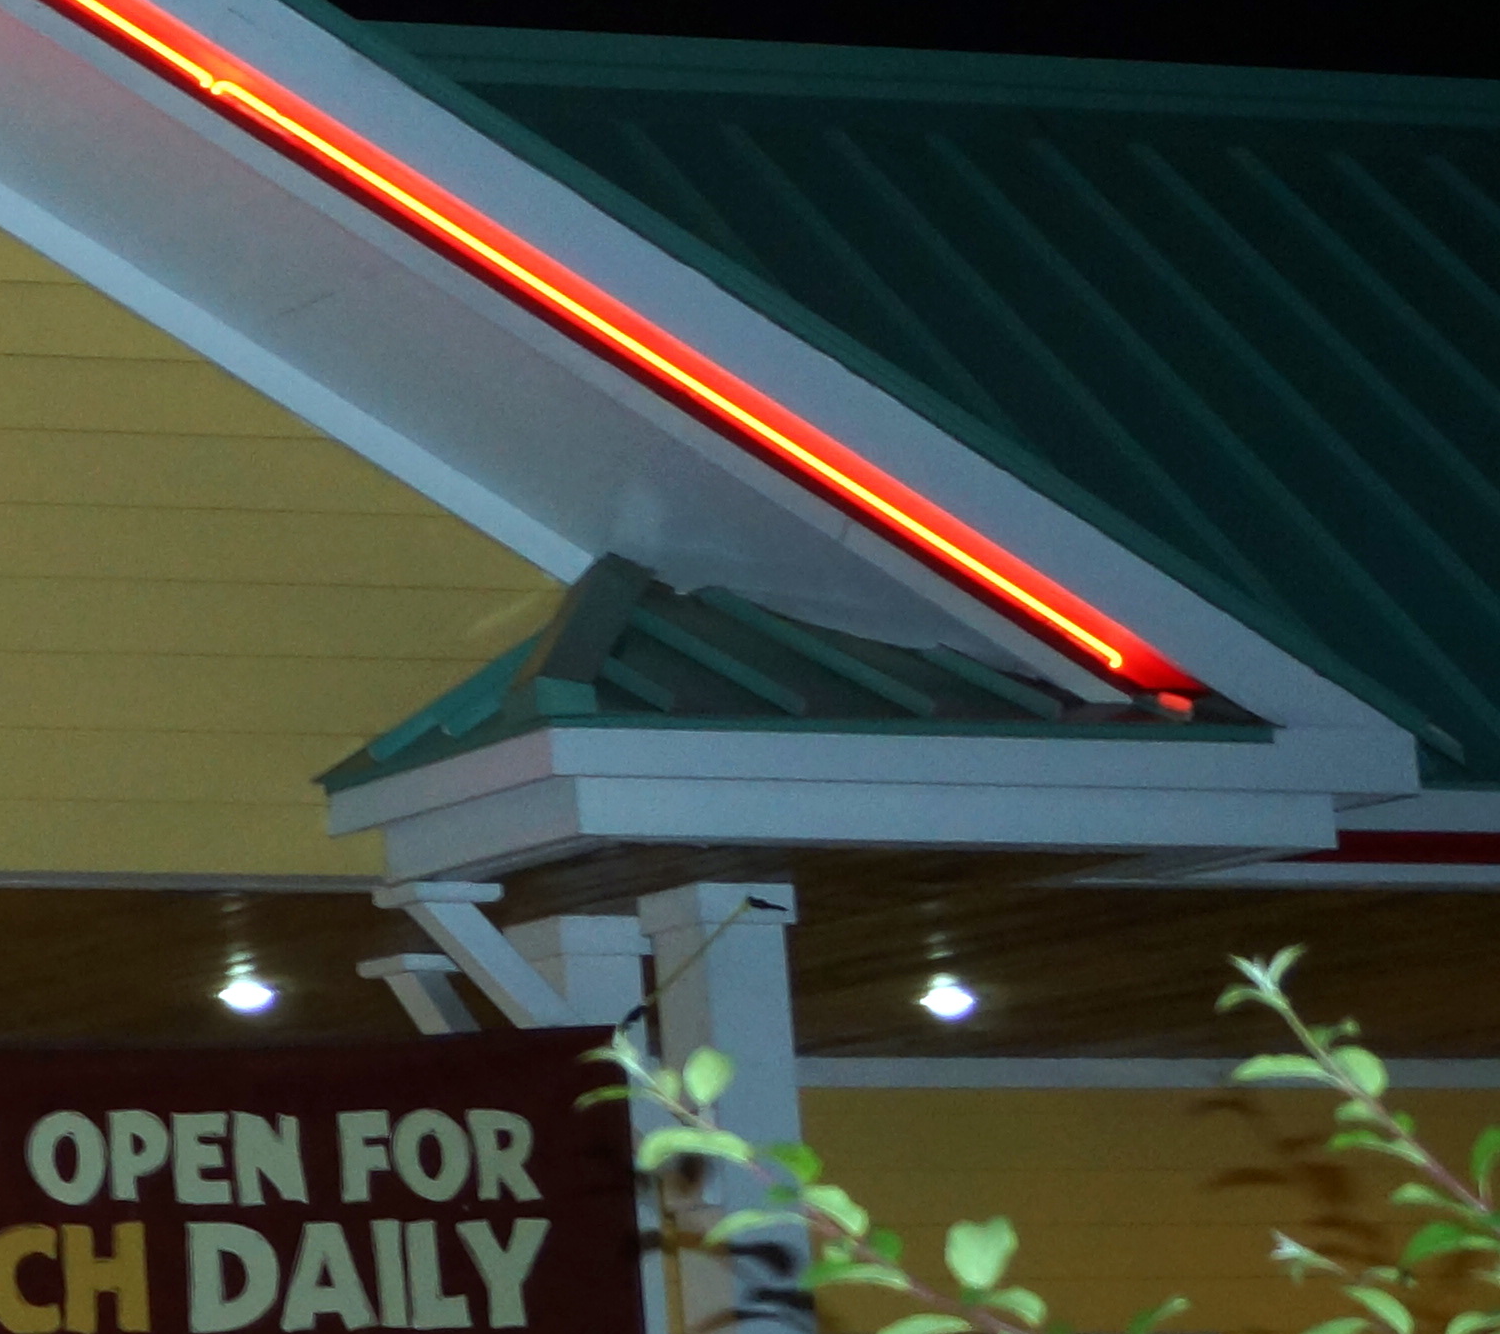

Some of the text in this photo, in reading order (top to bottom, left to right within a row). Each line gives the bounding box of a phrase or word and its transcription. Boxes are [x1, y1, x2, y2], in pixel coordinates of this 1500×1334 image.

[26, 1108, 310, 1207] OPEN
[337, 1108, 544, 1205] FOR
[184, 1216, 552, 1334] DAILY
